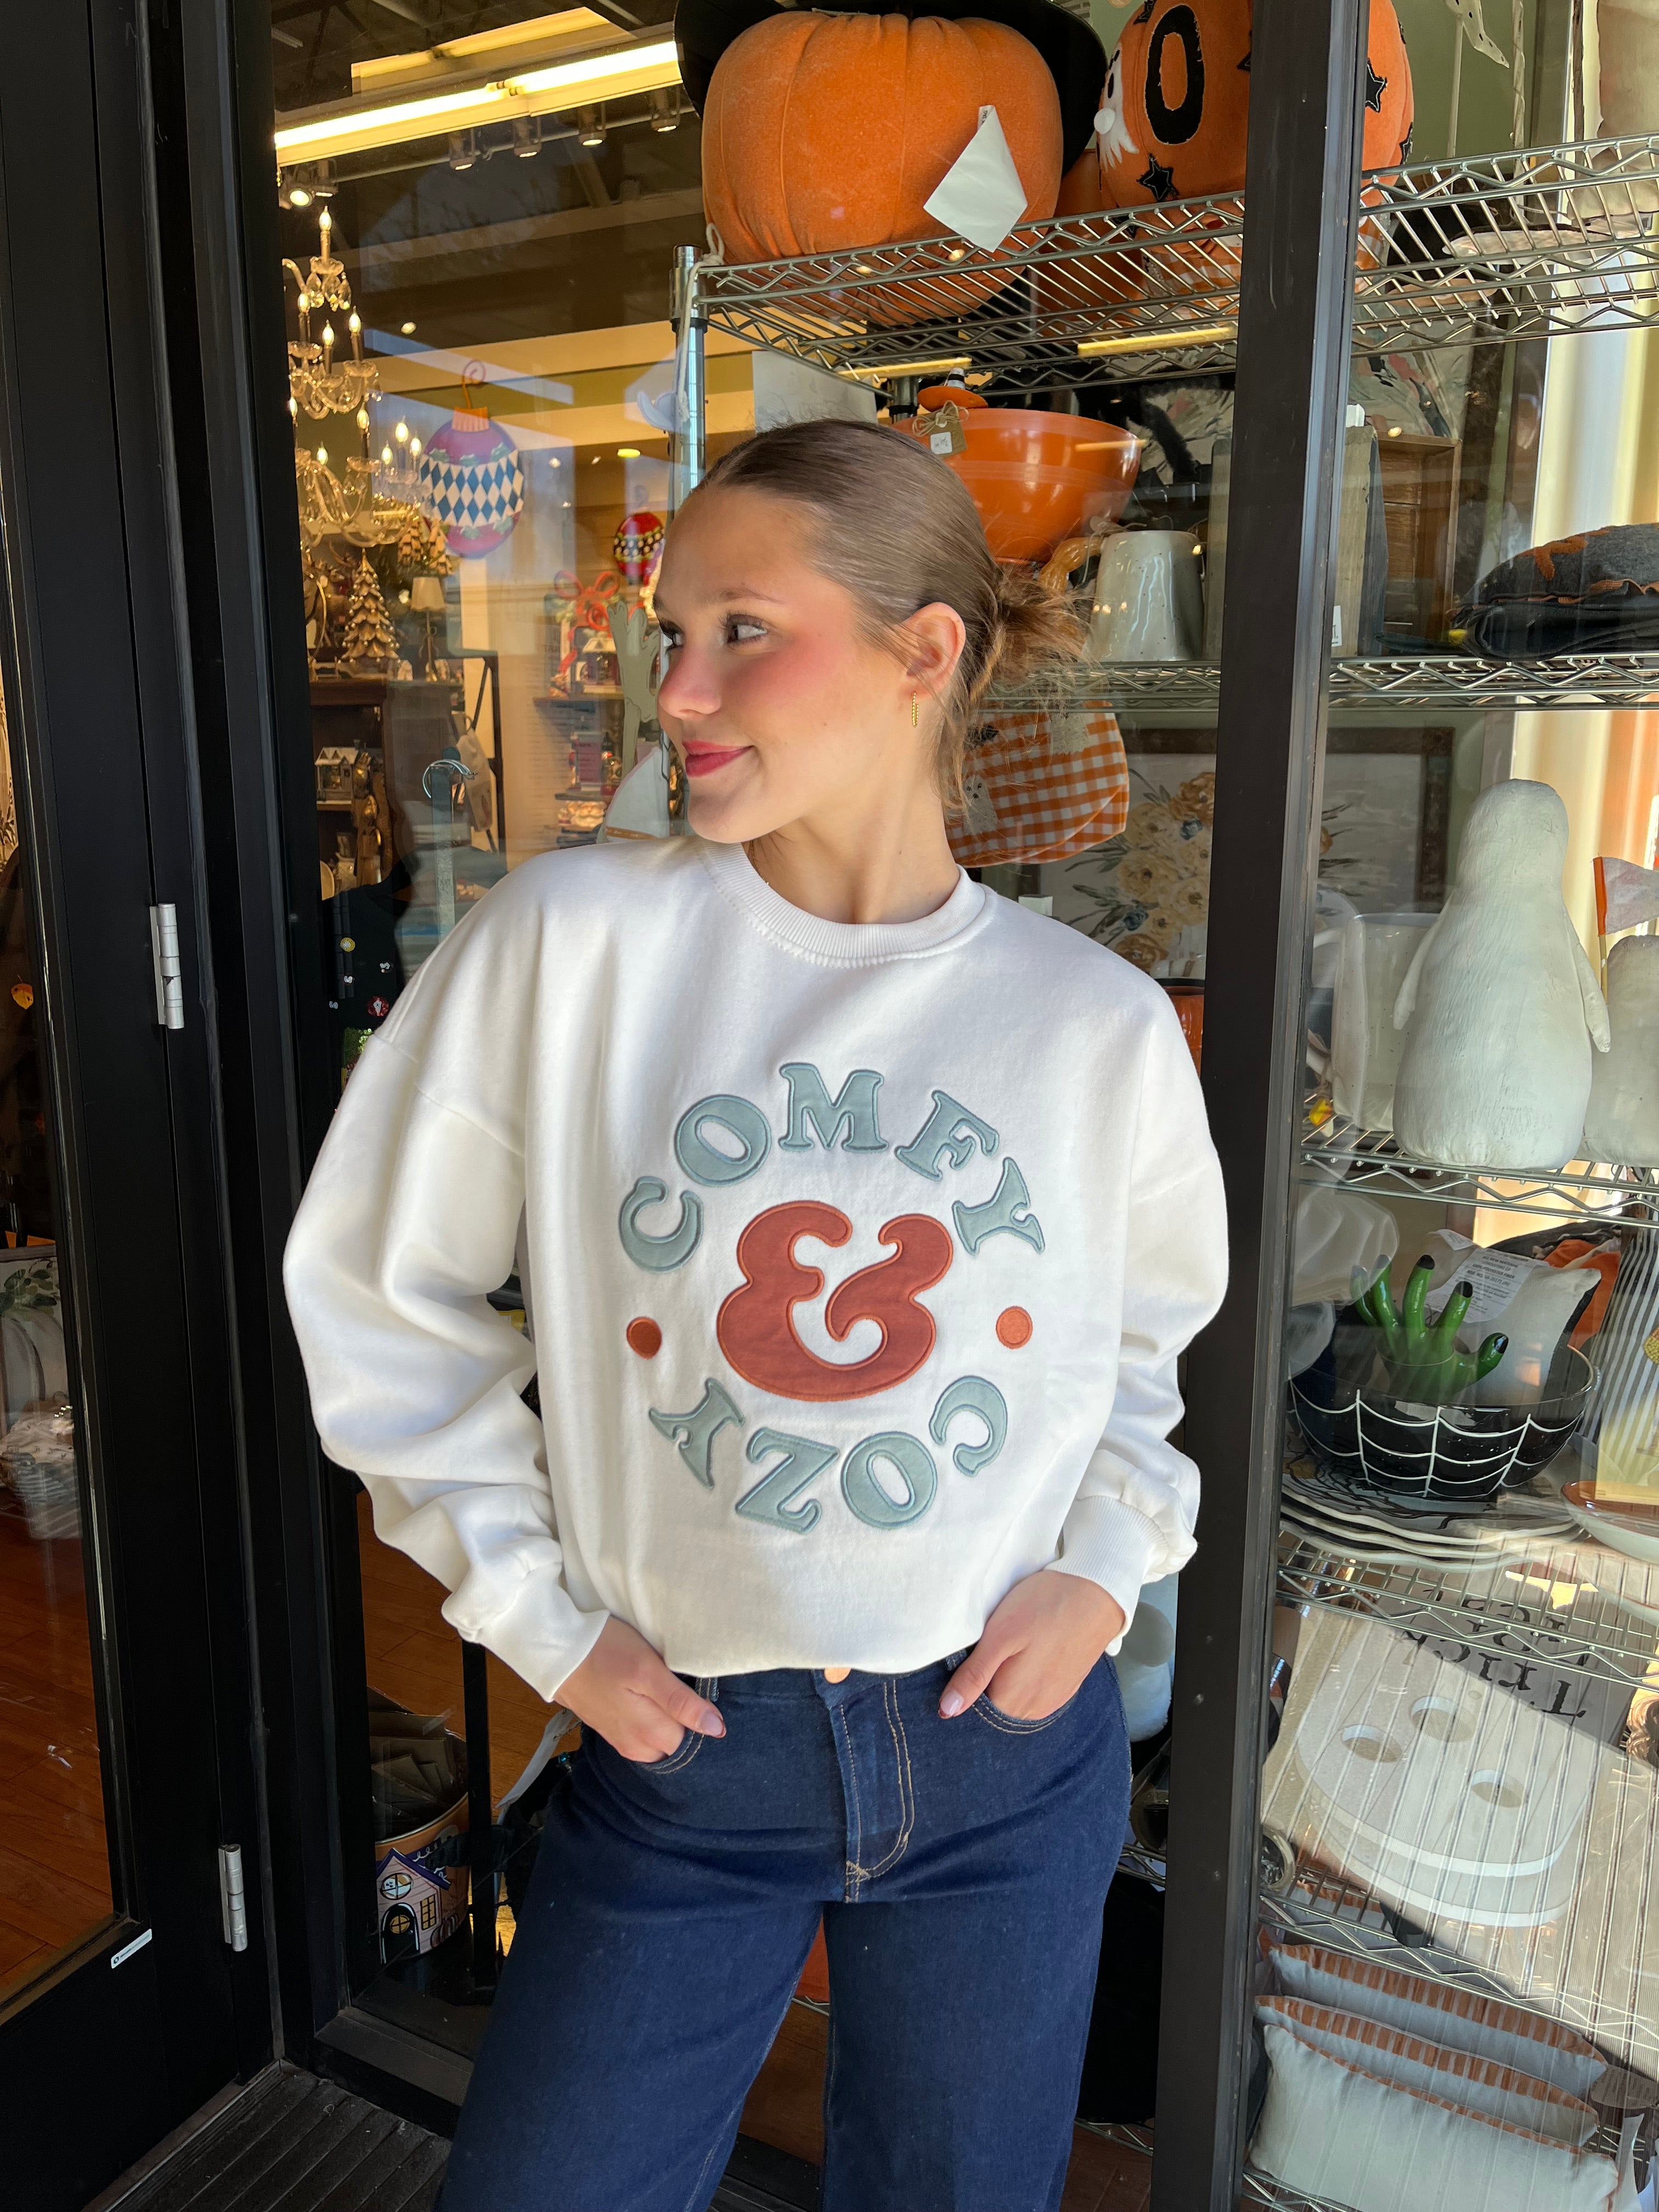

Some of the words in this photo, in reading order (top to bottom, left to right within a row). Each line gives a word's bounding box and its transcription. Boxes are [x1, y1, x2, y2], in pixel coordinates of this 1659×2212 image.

[618, 1062, 1046, 1273] COMFY
[716, 1200, 953, 1402] &
[1482, 1266, 1503, 1276] POLYESTER
[648, 1375, 1008, 1534] COZY
